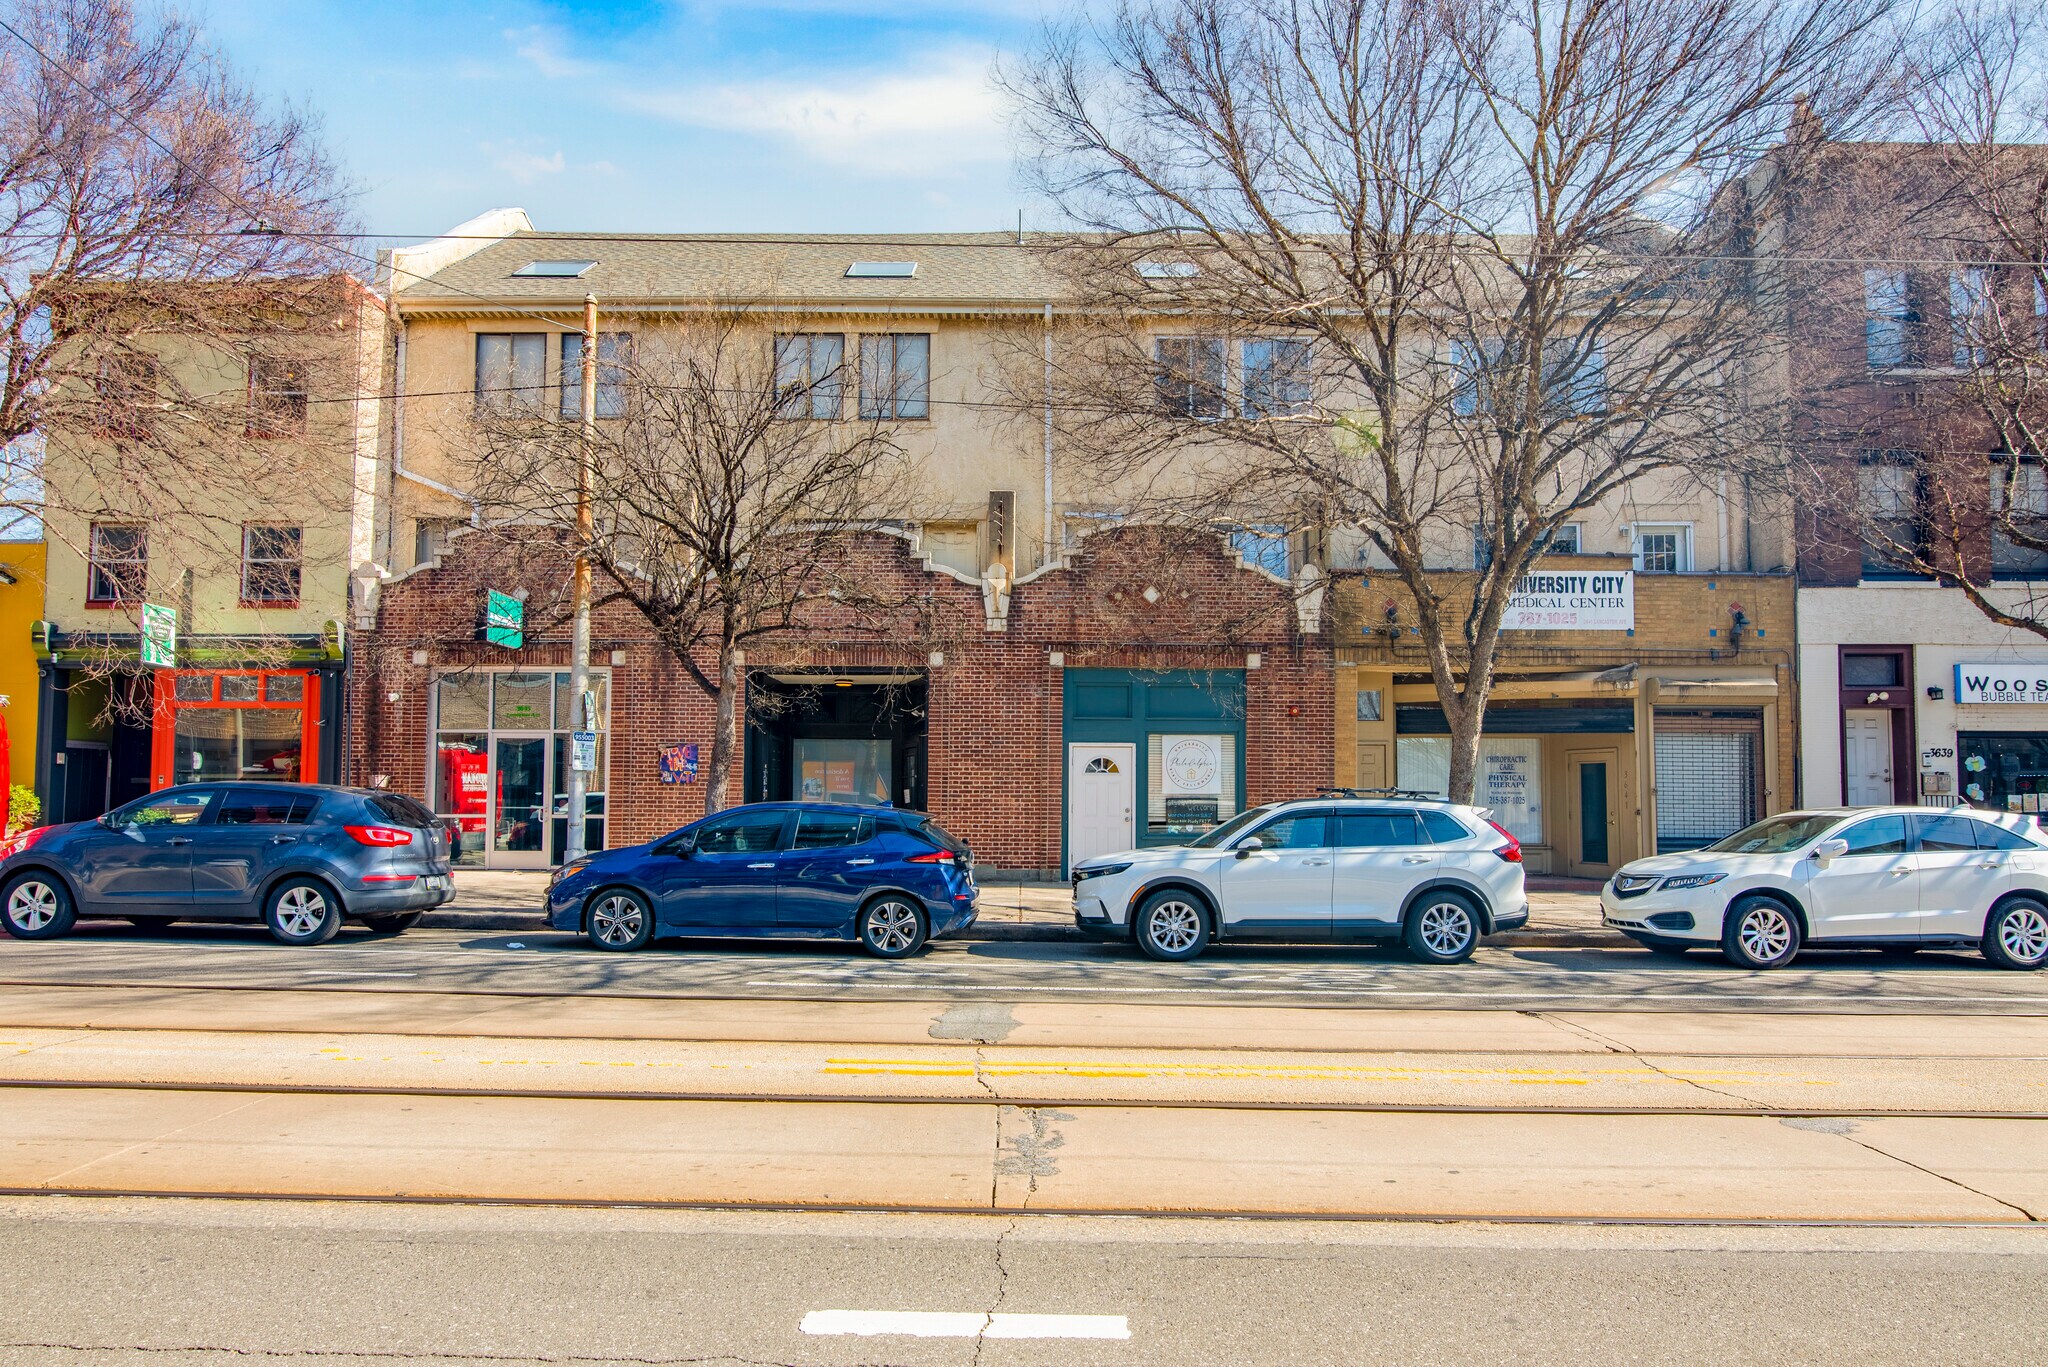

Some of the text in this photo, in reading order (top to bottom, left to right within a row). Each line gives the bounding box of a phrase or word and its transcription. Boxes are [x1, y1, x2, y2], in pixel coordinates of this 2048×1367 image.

[1512, 575, 1625, 594] NIVERSITY CITY
[1506, 597, 1625, 609] MEDICAL CENTER
[1981, 691, 2026, 702] BUBBLE
[1929, 748, 1954, 758] 3639
[1485, 755, 1528, 763] CHIROPRACTIC
[1488, 774, 1528, 782] PHYSICAL
[1488, 796, 1526, 805] 215-387-1025
